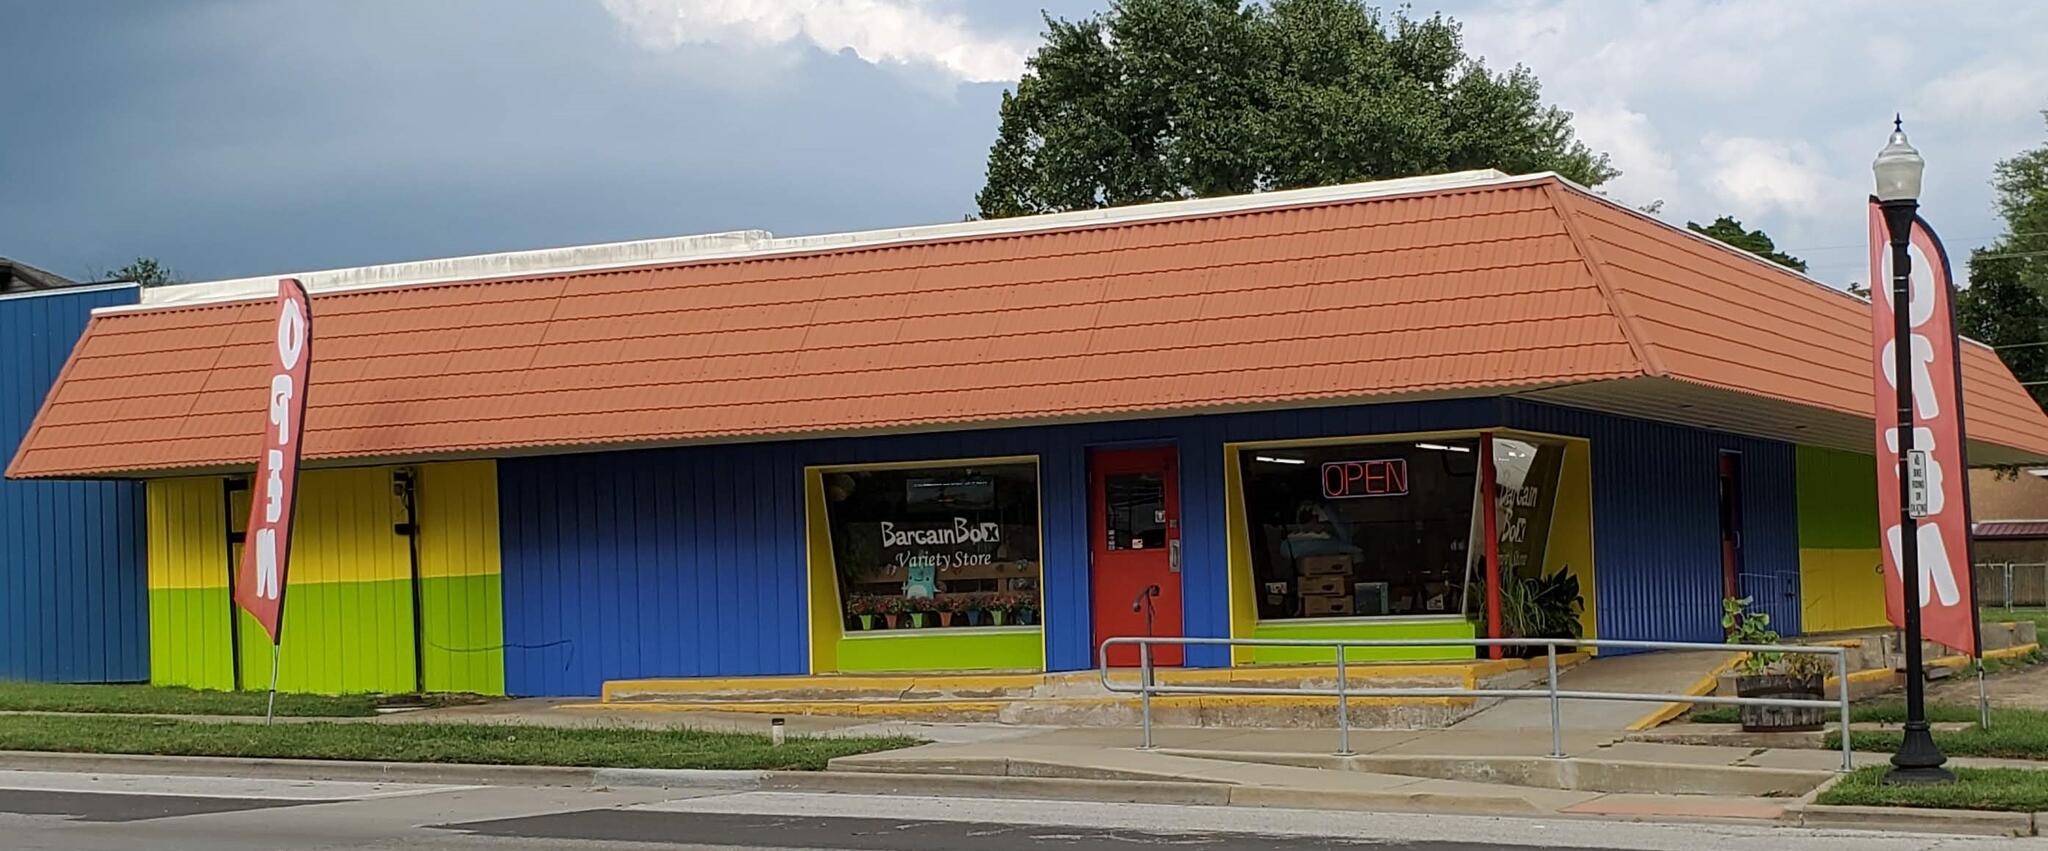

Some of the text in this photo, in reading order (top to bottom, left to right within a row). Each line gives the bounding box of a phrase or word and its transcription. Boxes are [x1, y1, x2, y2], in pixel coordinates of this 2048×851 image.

[1325, 461, 1405, 496] OPEN
[895, 550, 992, 572] Variety Store
